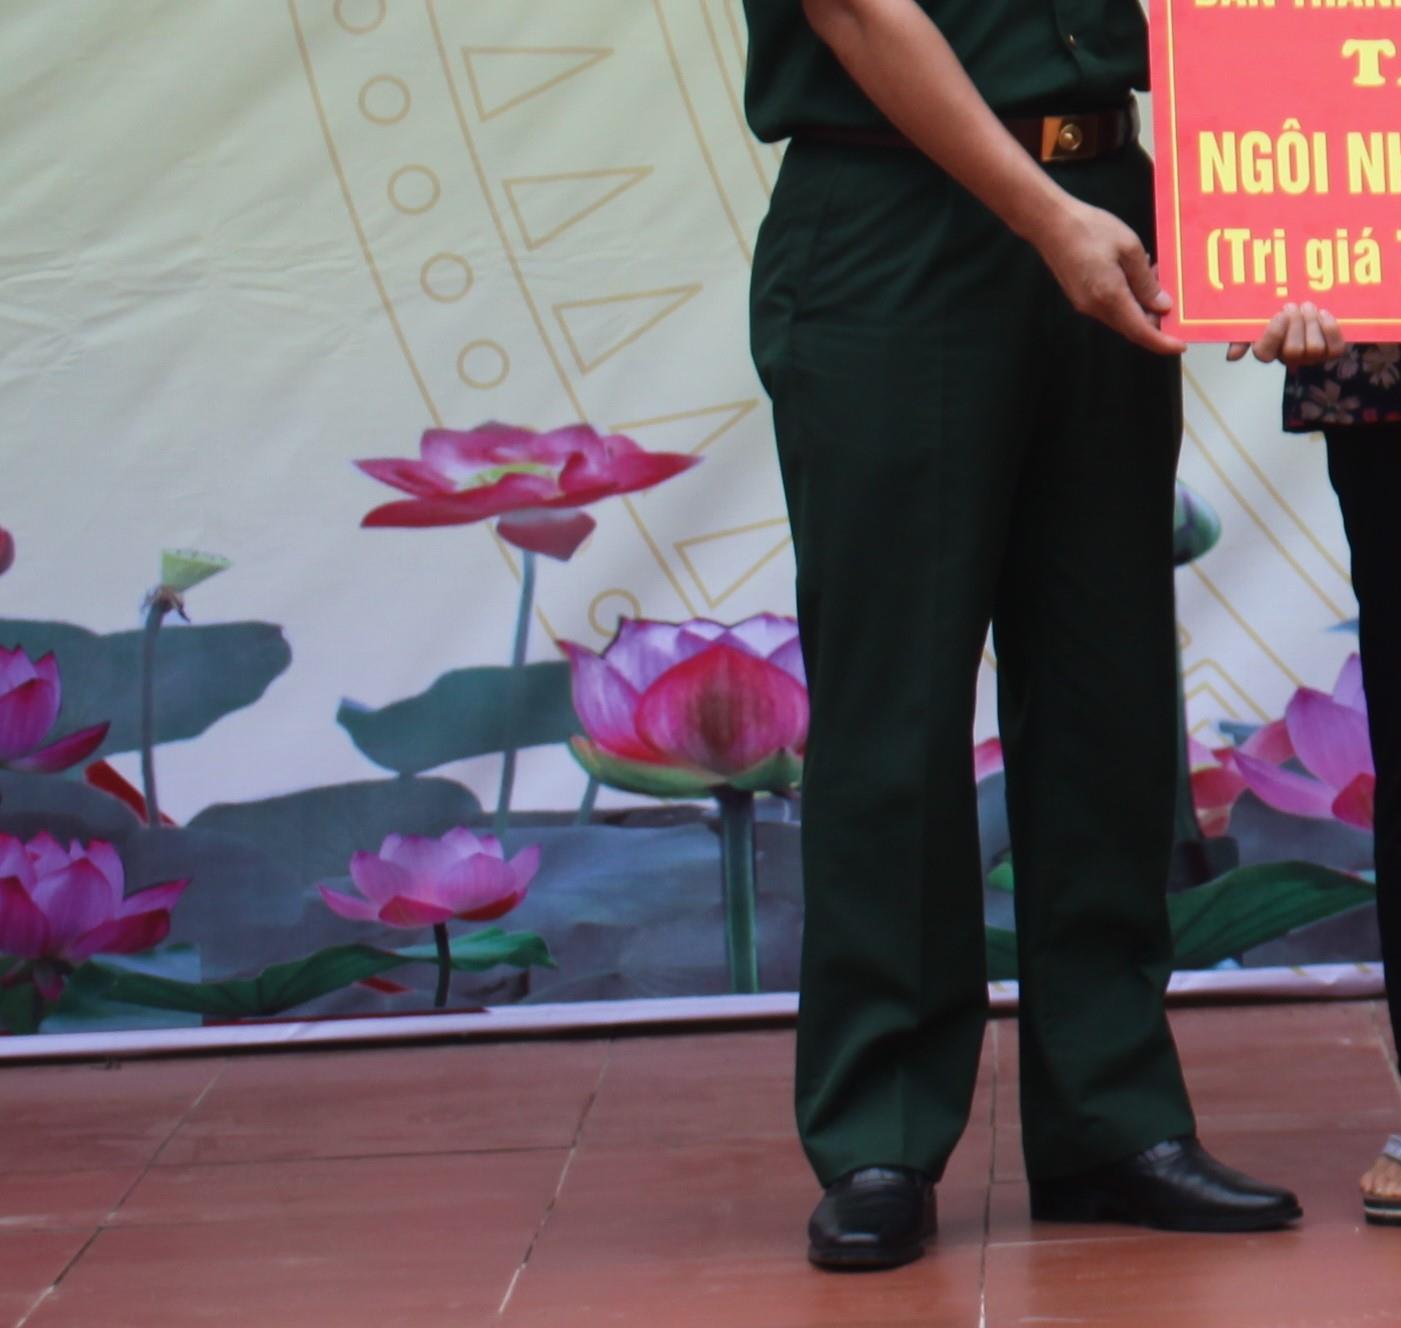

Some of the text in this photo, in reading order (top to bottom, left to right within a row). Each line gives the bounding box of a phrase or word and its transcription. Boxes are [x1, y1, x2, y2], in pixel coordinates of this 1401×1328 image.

[1198, 118, 1329, 196] NGÔI
[1206, 228, 1288, 297] (Trị
[1304, 227, 1382, 293] giá
